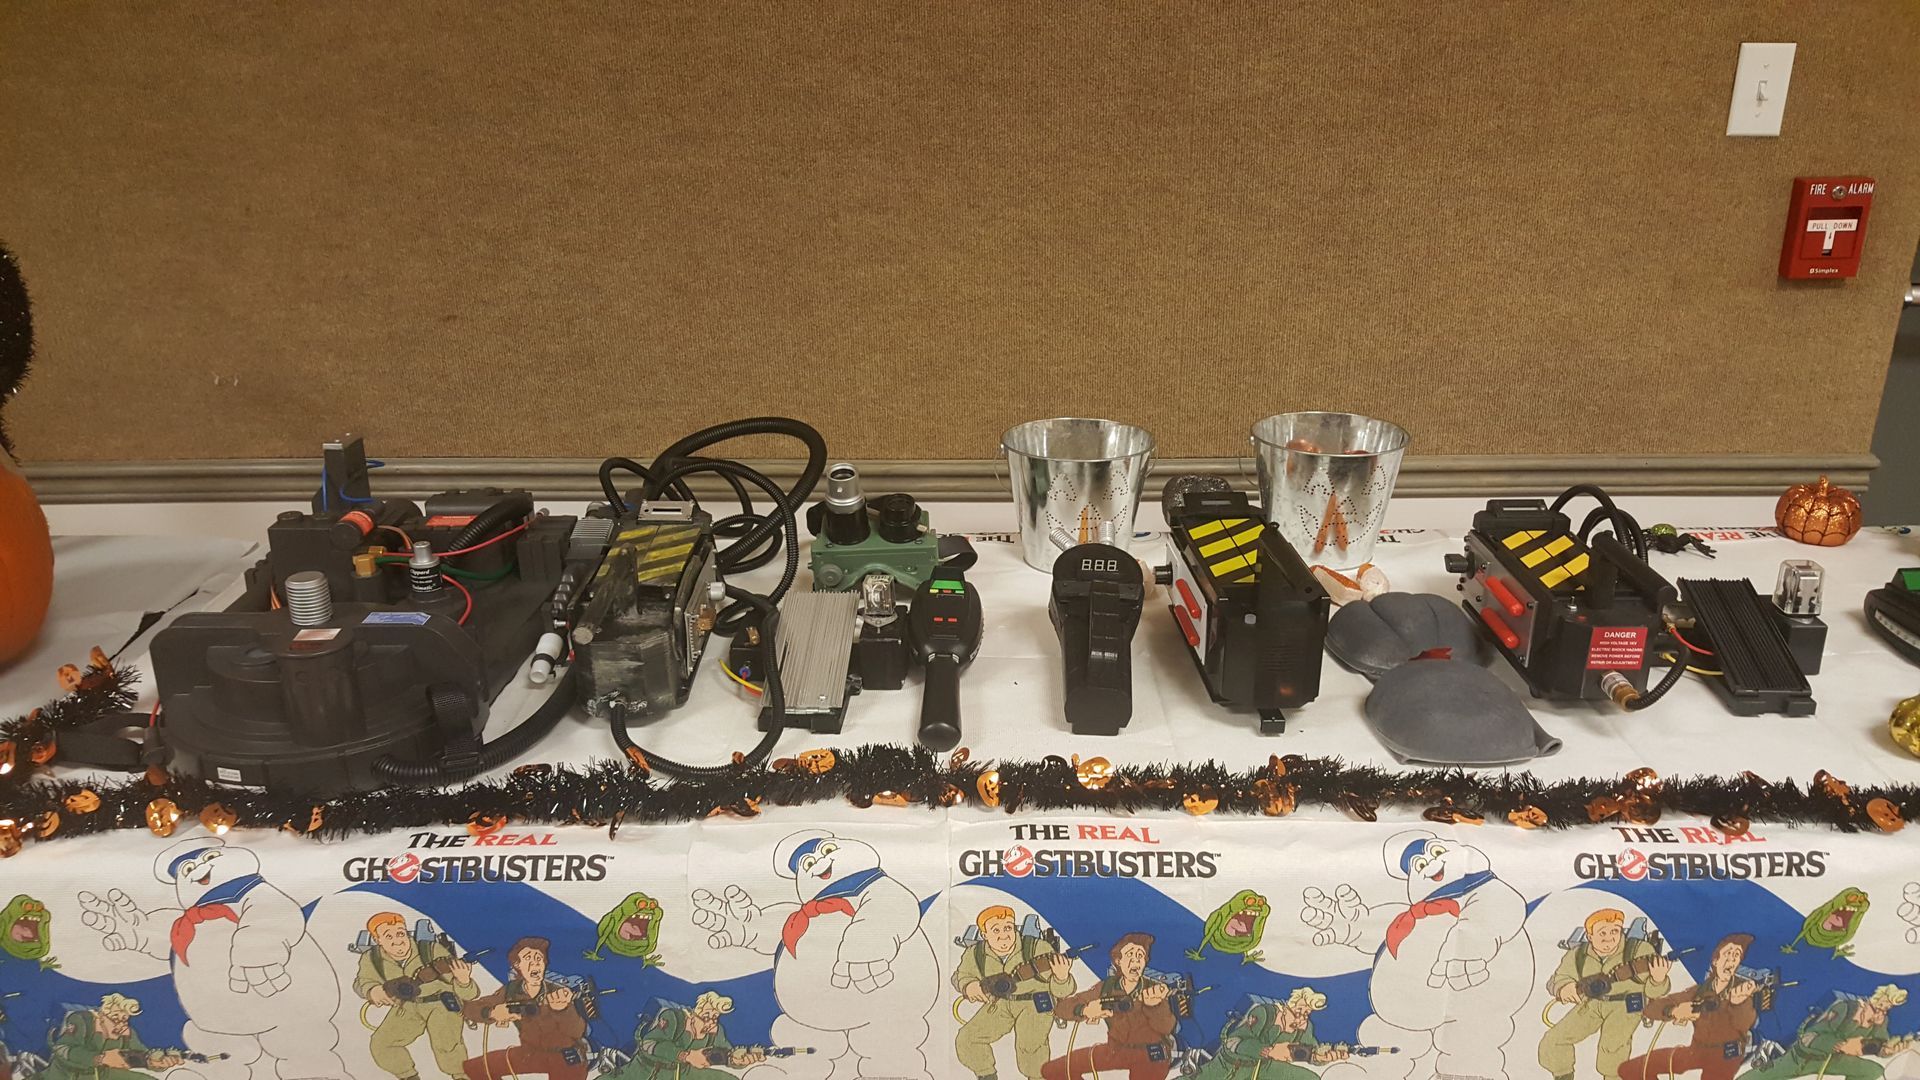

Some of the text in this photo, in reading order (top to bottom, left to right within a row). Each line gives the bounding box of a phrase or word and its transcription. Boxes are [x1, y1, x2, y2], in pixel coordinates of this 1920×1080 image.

[1809, 183, 1875, 195] FIRE ALARM
[1812, 222, 1853, 230] PULL DOWN
[1815, 267, 1839, 275] Simplex
[1603, 631, 1637, 639] DANGER
[1009, 824, 1160, 844] THE REAL
[1611, 827, 1680, 844] THE
[407, 832, 558, 849] THE REAL
